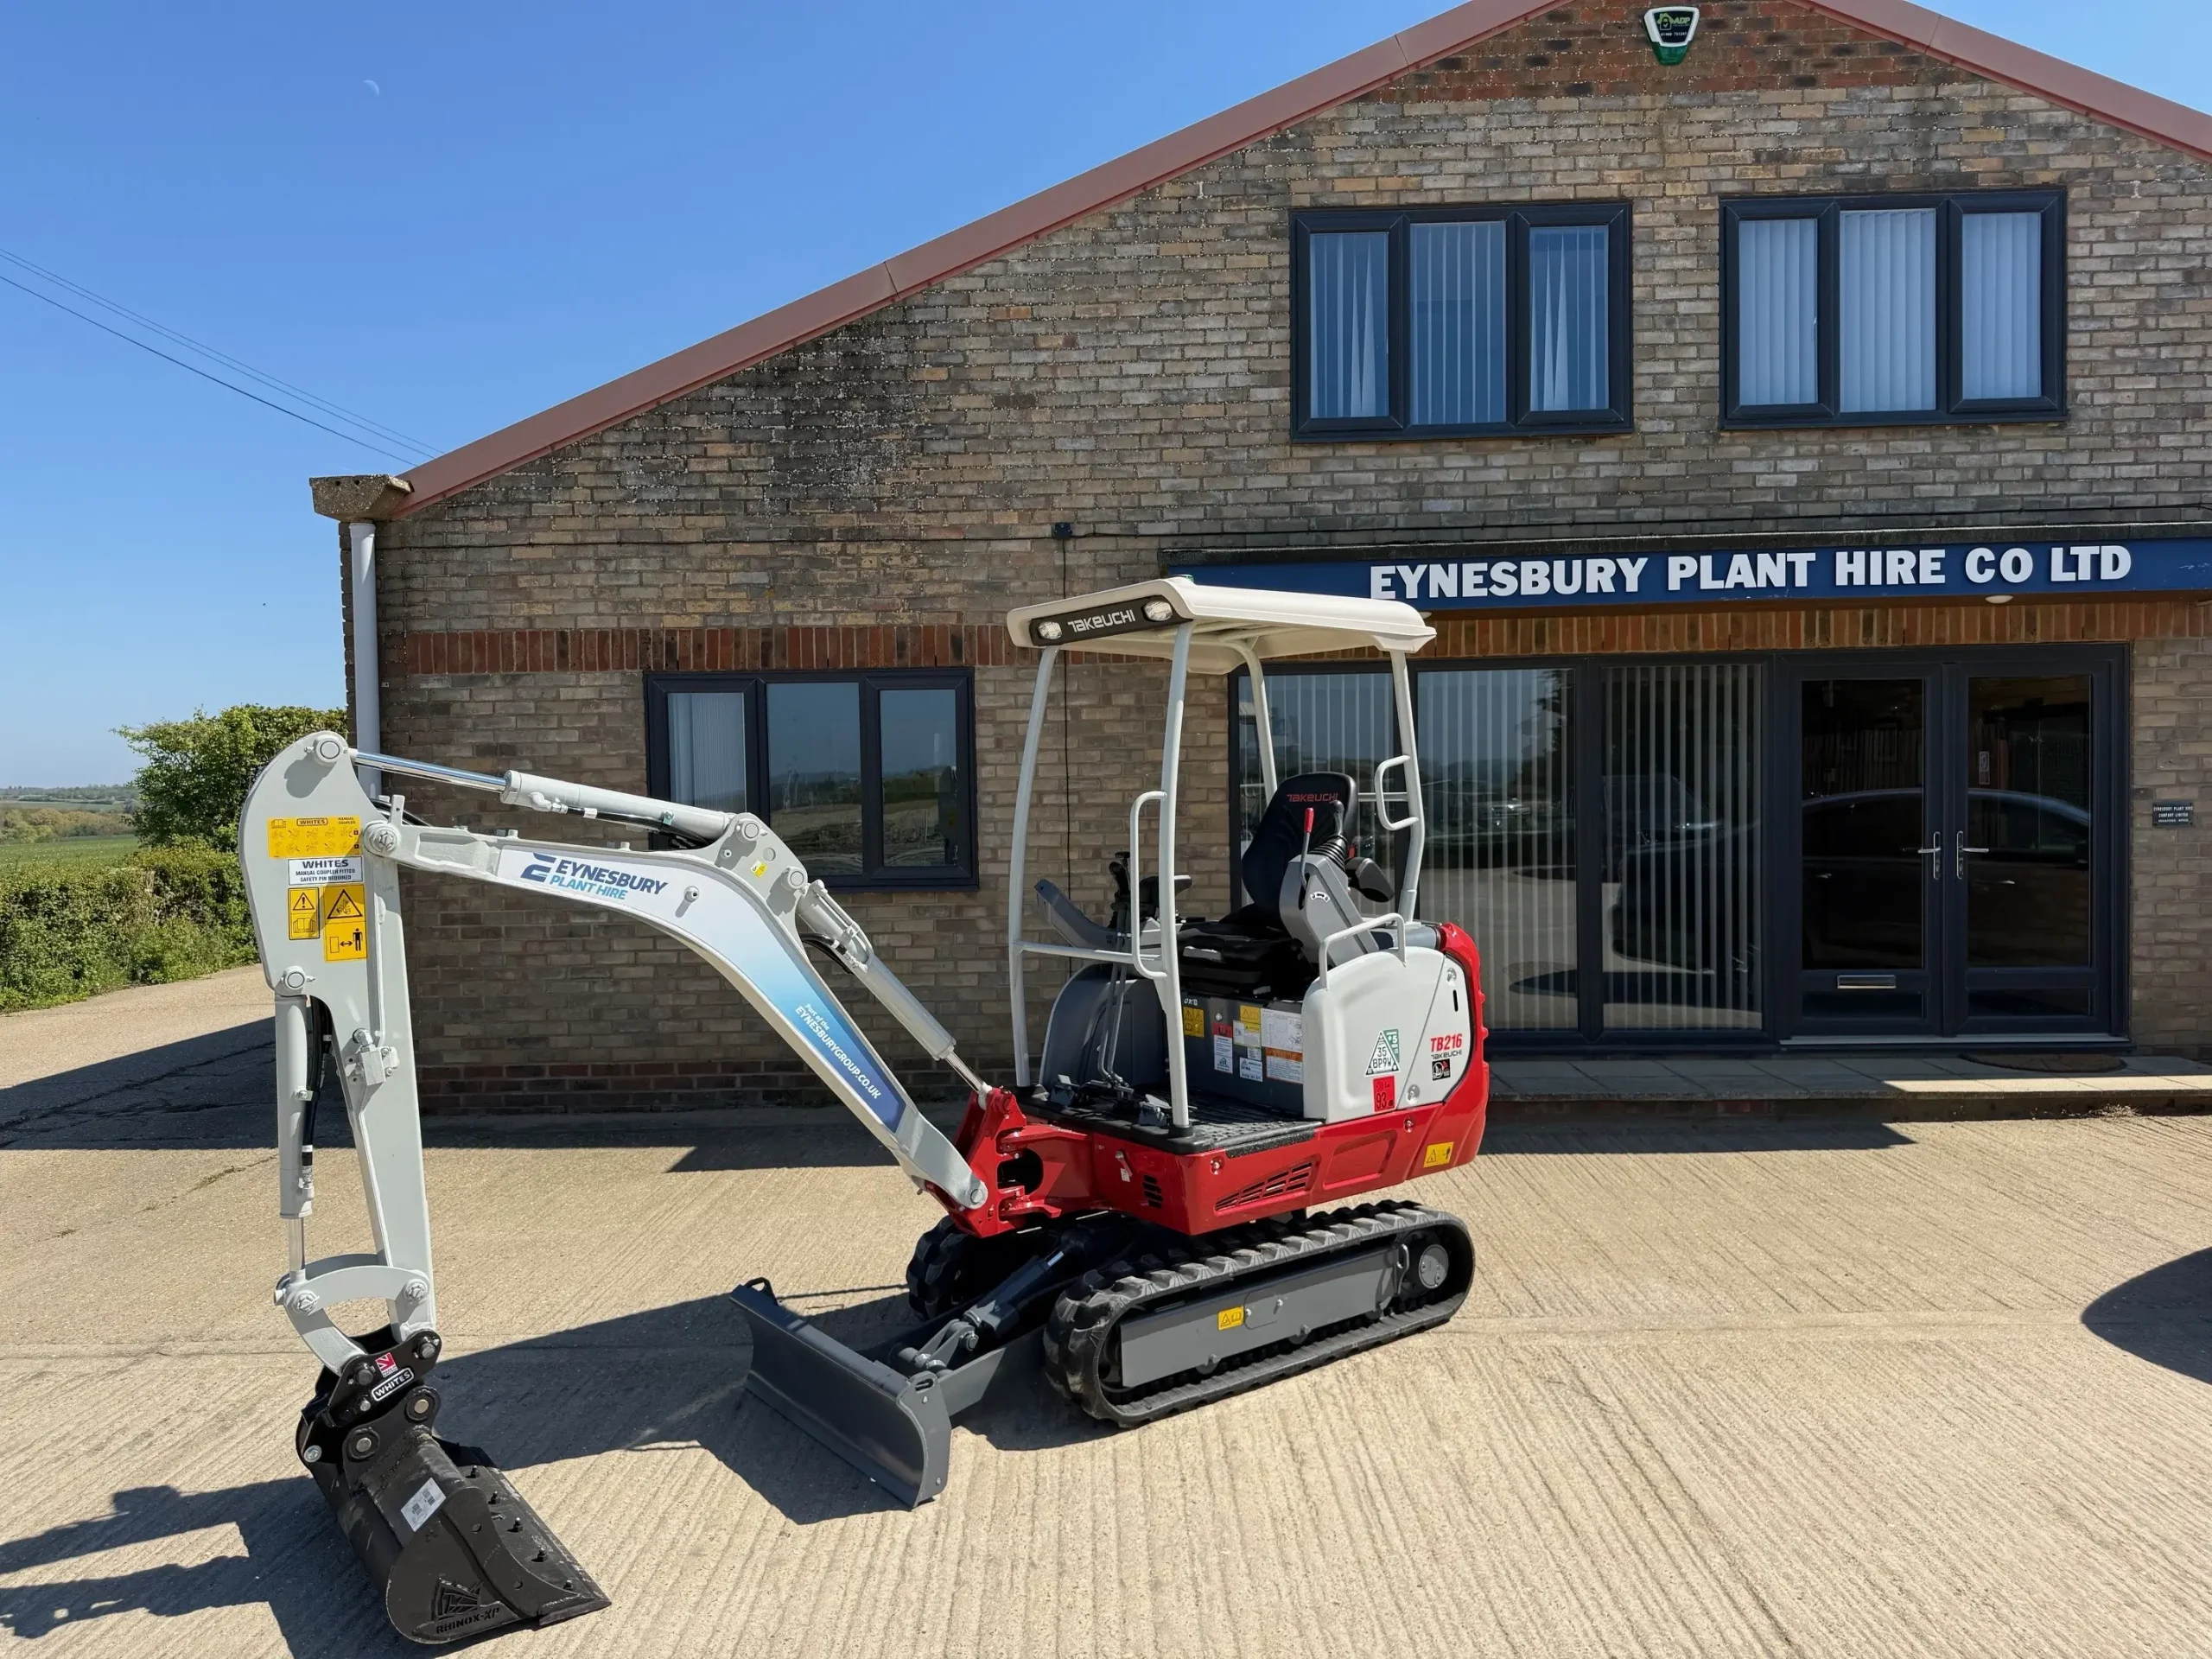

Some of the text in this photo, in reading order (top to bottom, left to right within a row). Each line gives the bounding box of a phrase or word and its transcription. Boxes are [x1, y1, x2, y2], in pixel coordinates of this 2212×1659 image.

[1370, 545, 2132, 599] EYNESBURY PLANT HIRE CO LTD
[1067, 609, 1136, 632] TAKEUCHI
[1287, 792, 1338, 803] TAKEUCHI
[302, 859, 349, 868] WHITES
[550, 874, 628, 899] PLANT HIRE
[556, 859, 668, 895] EYNESBURY
[804, 1003, 817, 1017] Part
[820, 1020, 830, 1031] the
[795, 1006, 881, 1100] EYNESBURYGROUP.CO.UK
[1376, 1046, 1387, 1058] 35
[1430, 1033, 1463, 1052] TB216
[1431, 1049, 1463, 1060] TAKEUCHI
[1376, 1091, 1387, 1109] 93
[375, 1371, 410, 1397] WHITES
[436, 1607, 499, 1634] RHINOX-XP
